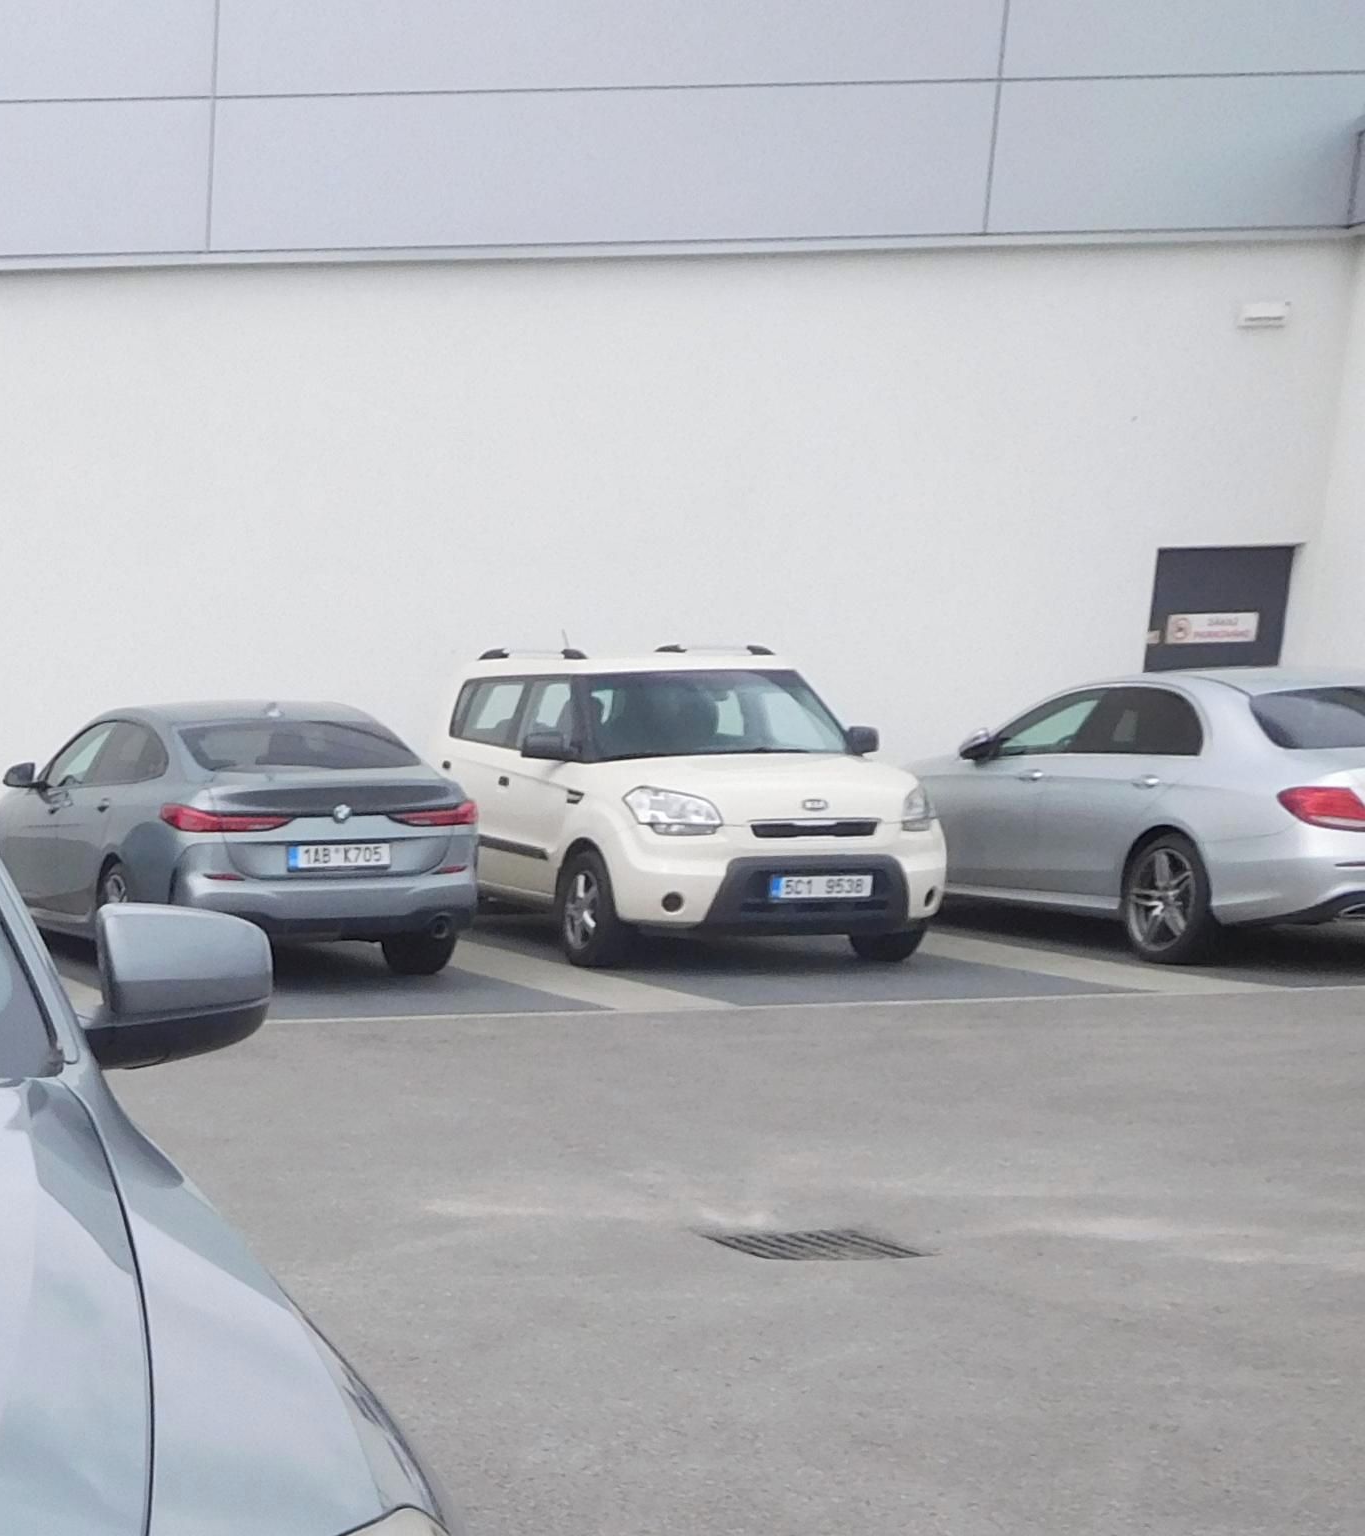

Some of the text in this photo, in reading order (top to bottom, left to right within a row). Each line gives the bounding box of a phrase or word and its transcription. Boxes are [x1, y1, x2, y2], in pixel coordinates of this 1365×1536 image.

[304, 845, 382, 864] 1AB K705
[784, 879, 812, 895] 5C1
